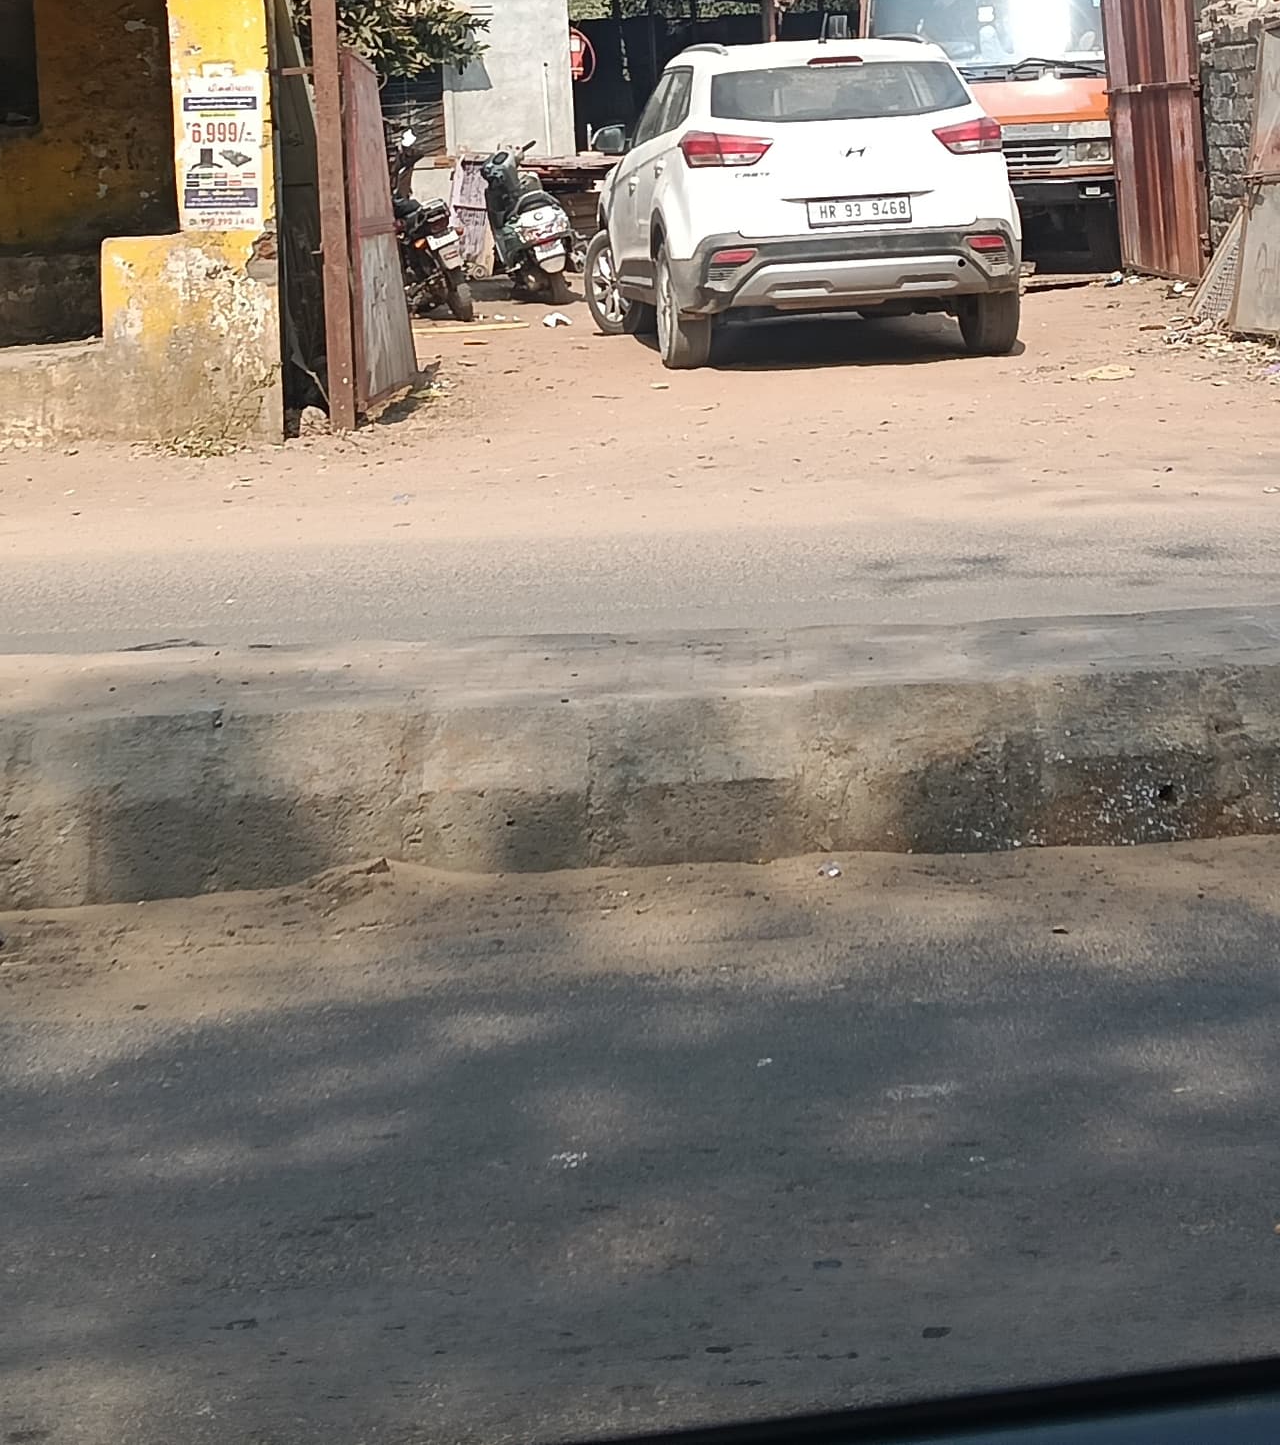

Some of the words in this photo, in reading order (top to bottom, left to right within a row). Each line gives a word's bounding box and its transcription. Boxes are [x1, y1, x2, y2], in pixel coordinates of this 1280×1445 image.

[819, 204, 836, 219] HR
[844, 203, 862, 218] 93
[871, 200, 907, 216] 9468
